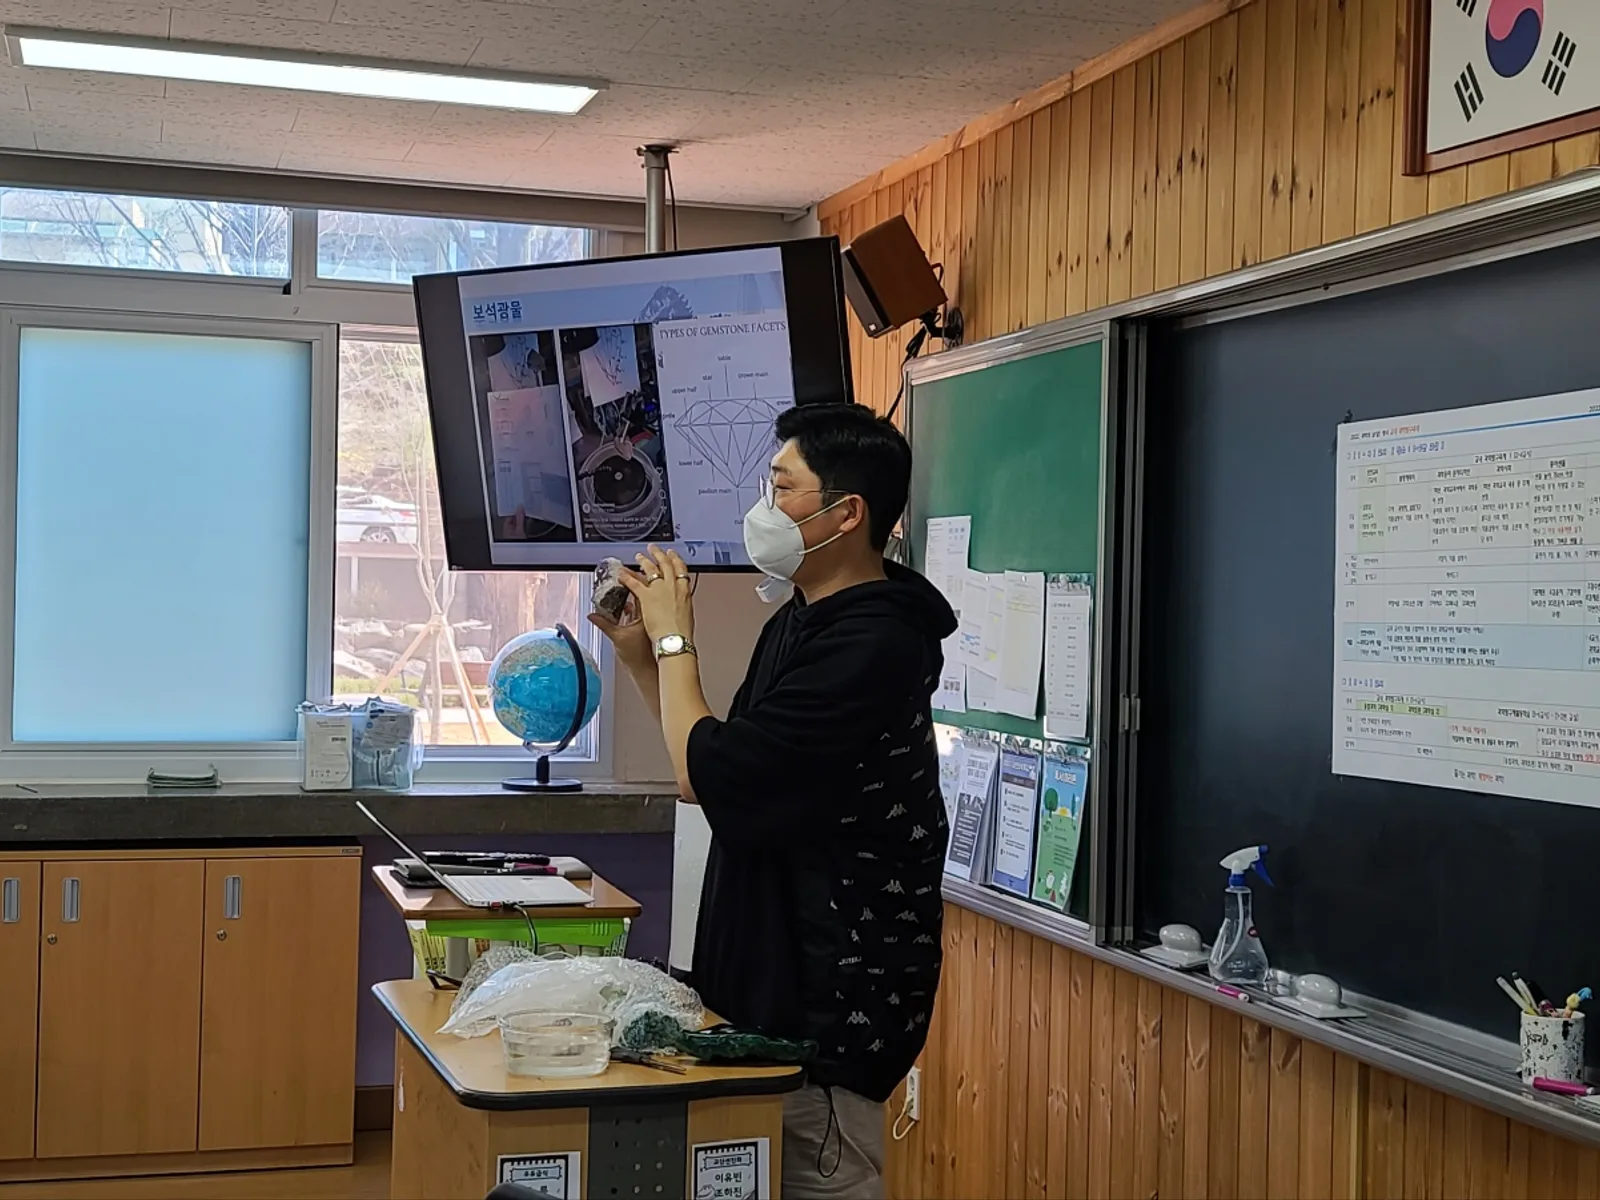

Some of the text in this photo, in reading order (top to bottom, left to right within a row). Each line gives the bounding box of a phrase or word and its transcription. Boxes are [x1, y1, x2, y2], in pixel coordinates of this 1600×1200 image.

[472, 300, 522, 321] 보석광물
[659, 320, 786, 340] TYPES OF GEMSTONE FACETS
[715, 1171, 742, 1184] 이유빈
[715, 1186, 742, 1198] 조하진
